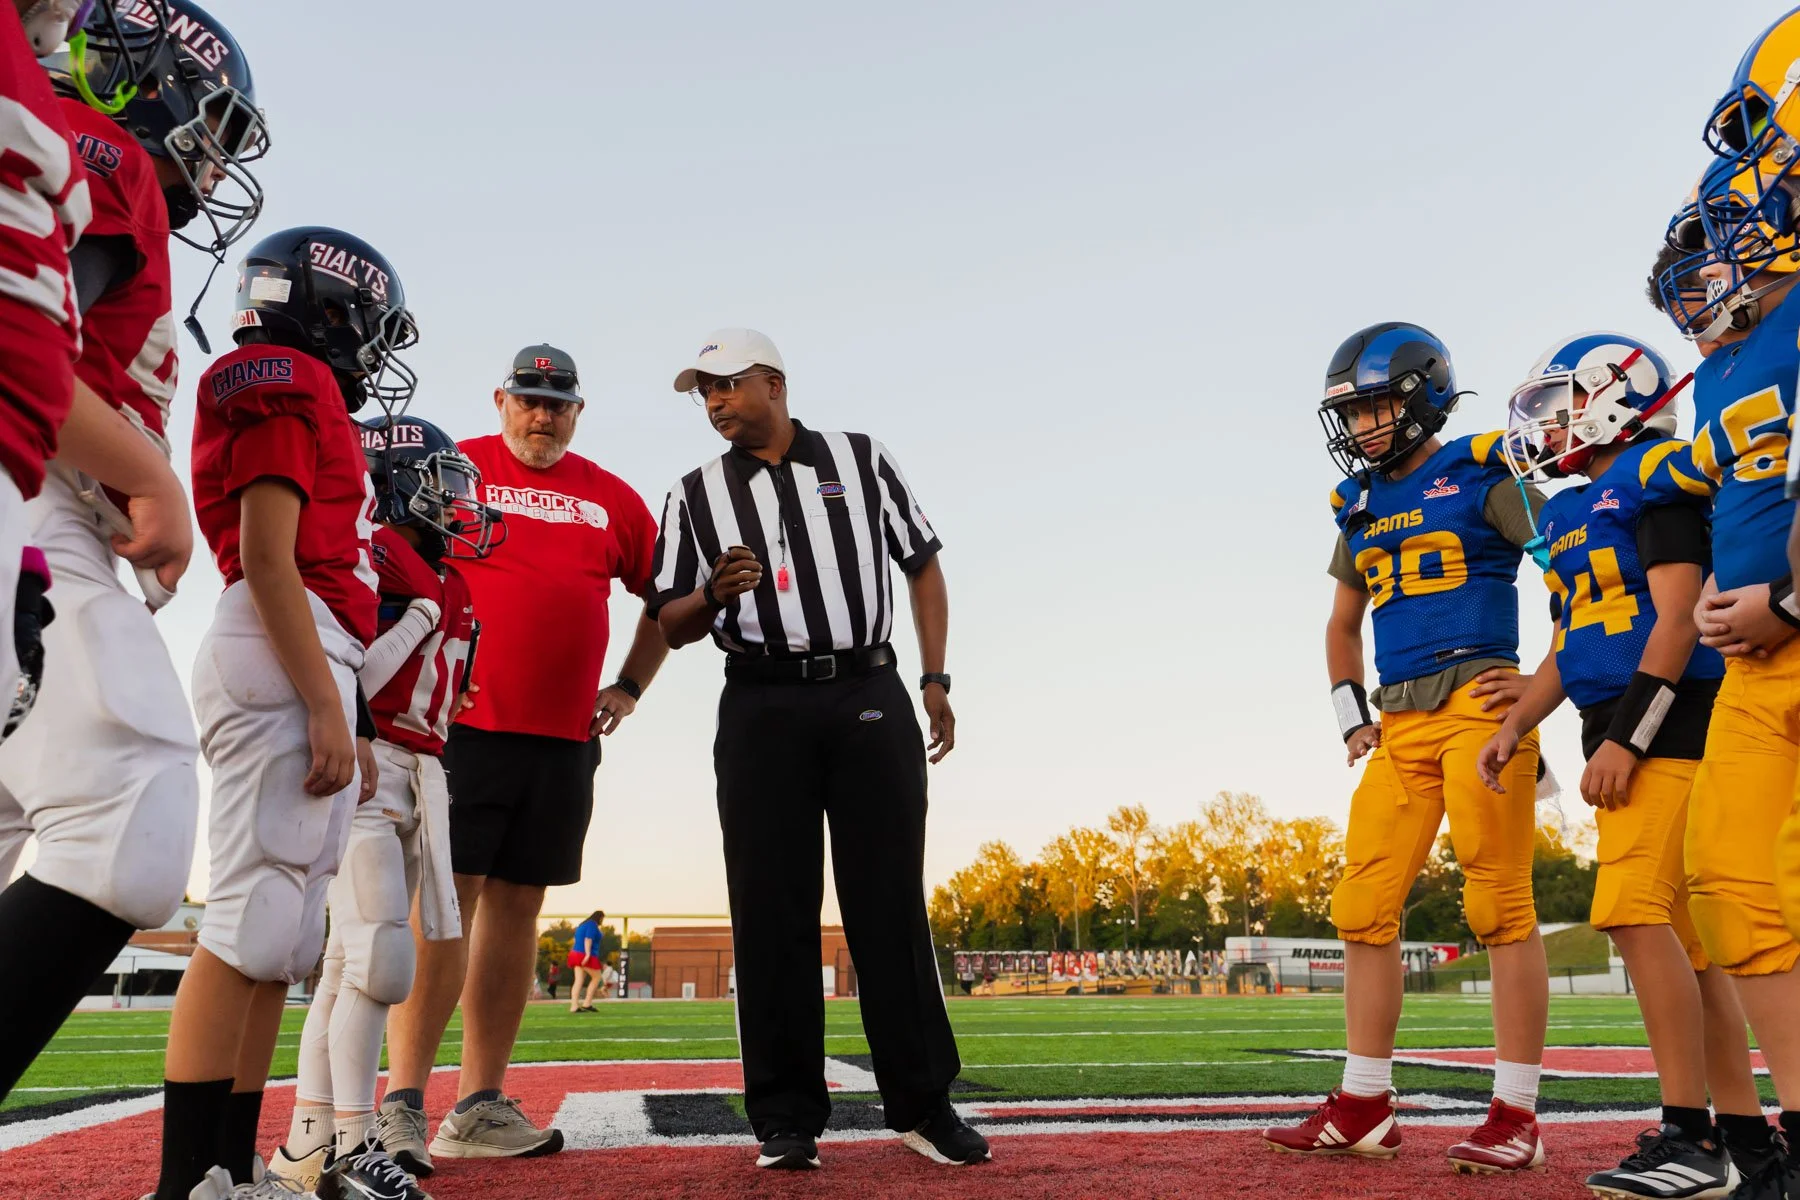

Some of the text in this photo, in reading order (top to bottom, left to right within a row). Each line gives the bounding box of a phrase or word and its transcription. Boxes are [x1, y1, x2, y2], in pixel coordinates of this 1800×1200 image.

[211, 358, 293, 398] GIANTS
[485, 487, 578, 513] HANCOCK
[1355, 530, 1468, 608] 80
[1291, 948, 1345, 960] HANCO
